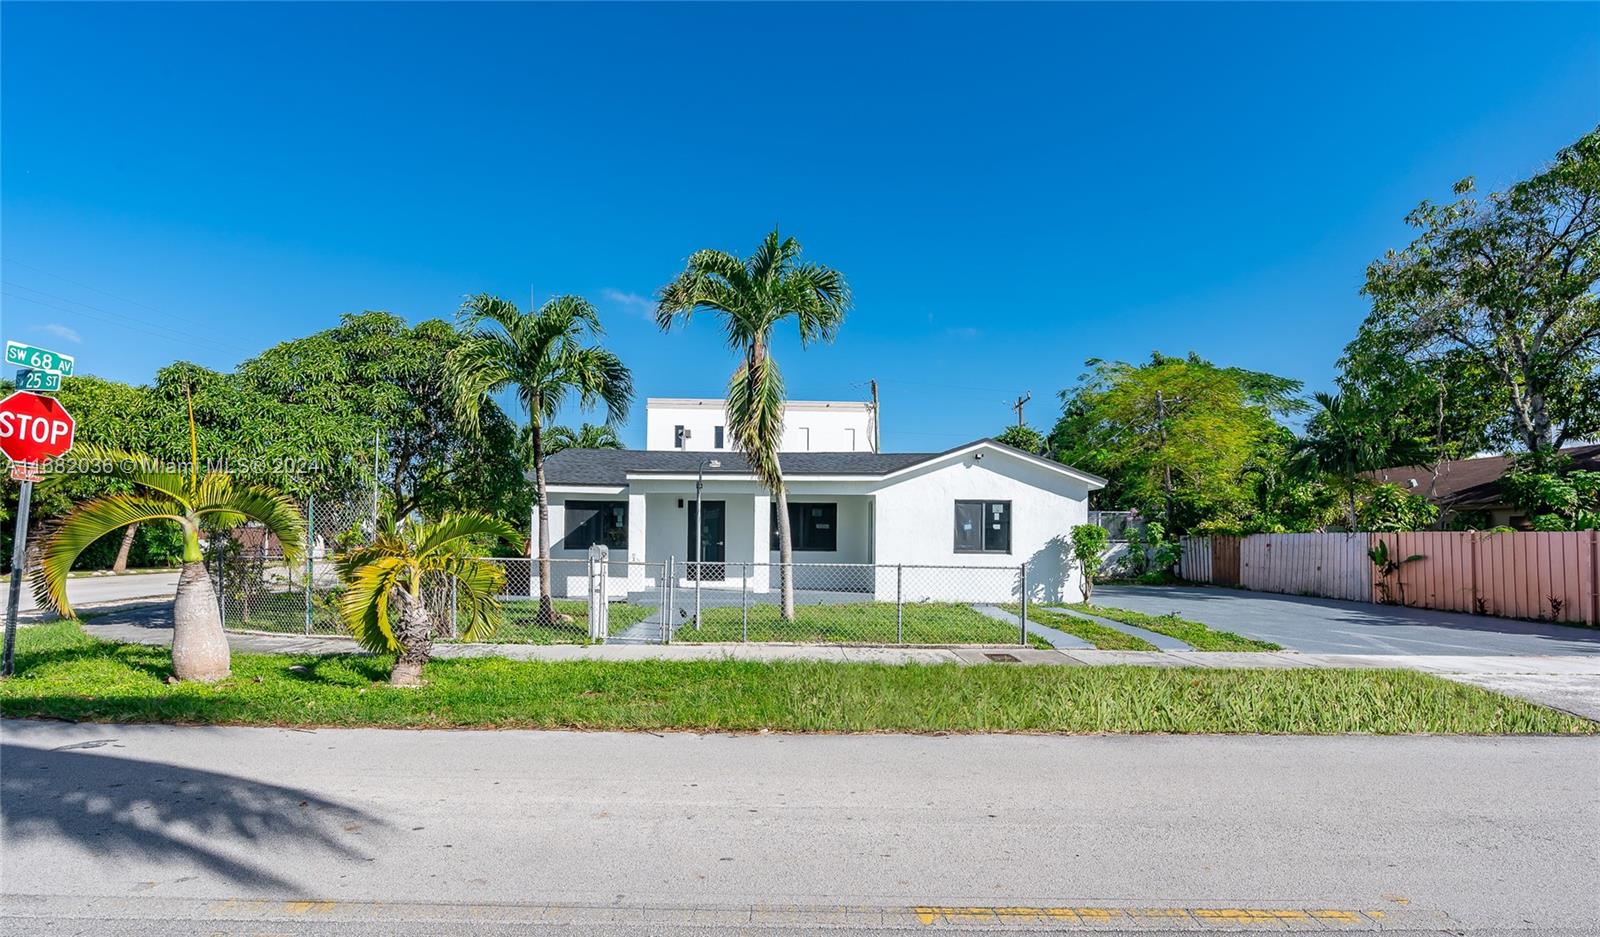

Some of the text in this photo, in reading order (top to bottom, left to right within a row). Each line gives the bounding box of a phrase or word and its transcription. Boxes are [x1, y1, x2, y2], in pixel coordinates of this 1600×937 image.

[9, 347, 71, 372] SW 68 AV
[26, 372, 42, 388] 25
[45, 375, 58, 387] ST
[0, 411, 69, 445] STOP
